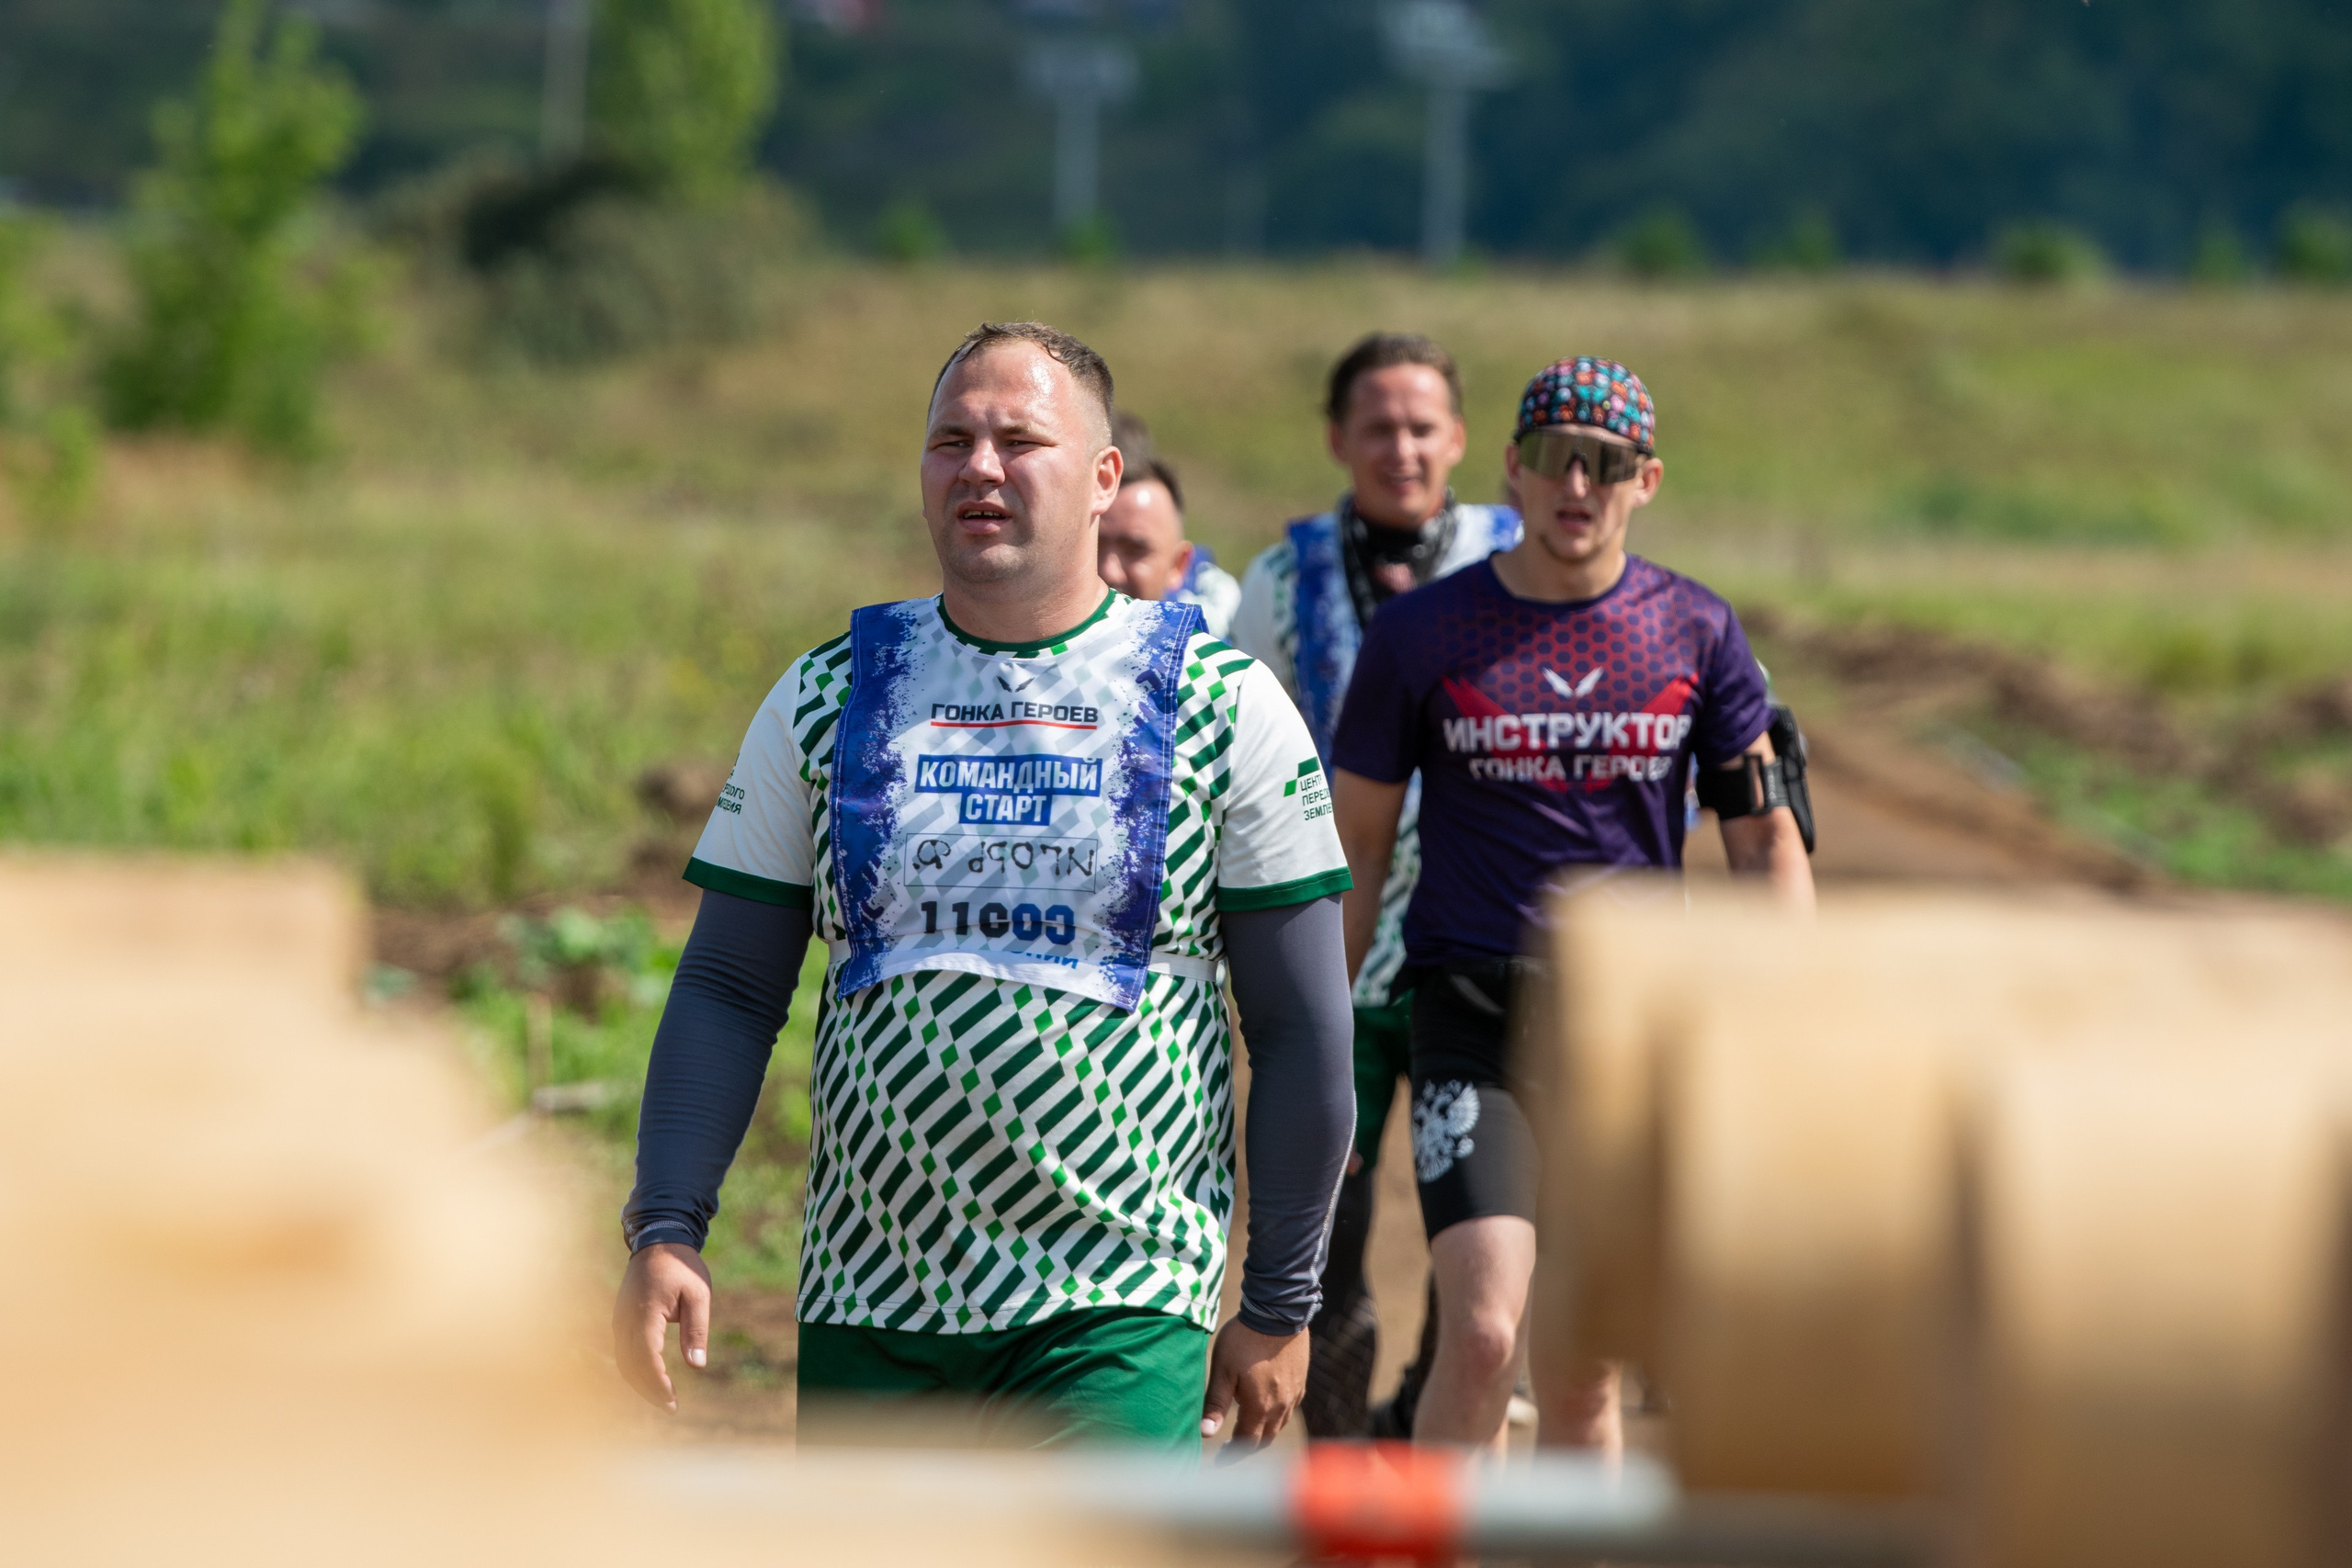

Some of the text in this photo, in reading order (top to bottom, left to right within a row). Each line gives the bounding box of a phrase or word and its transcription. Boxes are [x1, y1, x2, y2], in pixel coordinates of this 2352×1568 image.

[931, 701, 1099, 723] ГОНКА ГЕРОЕВ
[1442, 711, 1692, 752] ИНСТРУКТОР
[919, 758, 1098, 794] КОМАНДНЫЙ
[1469, 755, 1566, 781] ГОНКА
[965, 793, 1047, 822] СТАРТ
